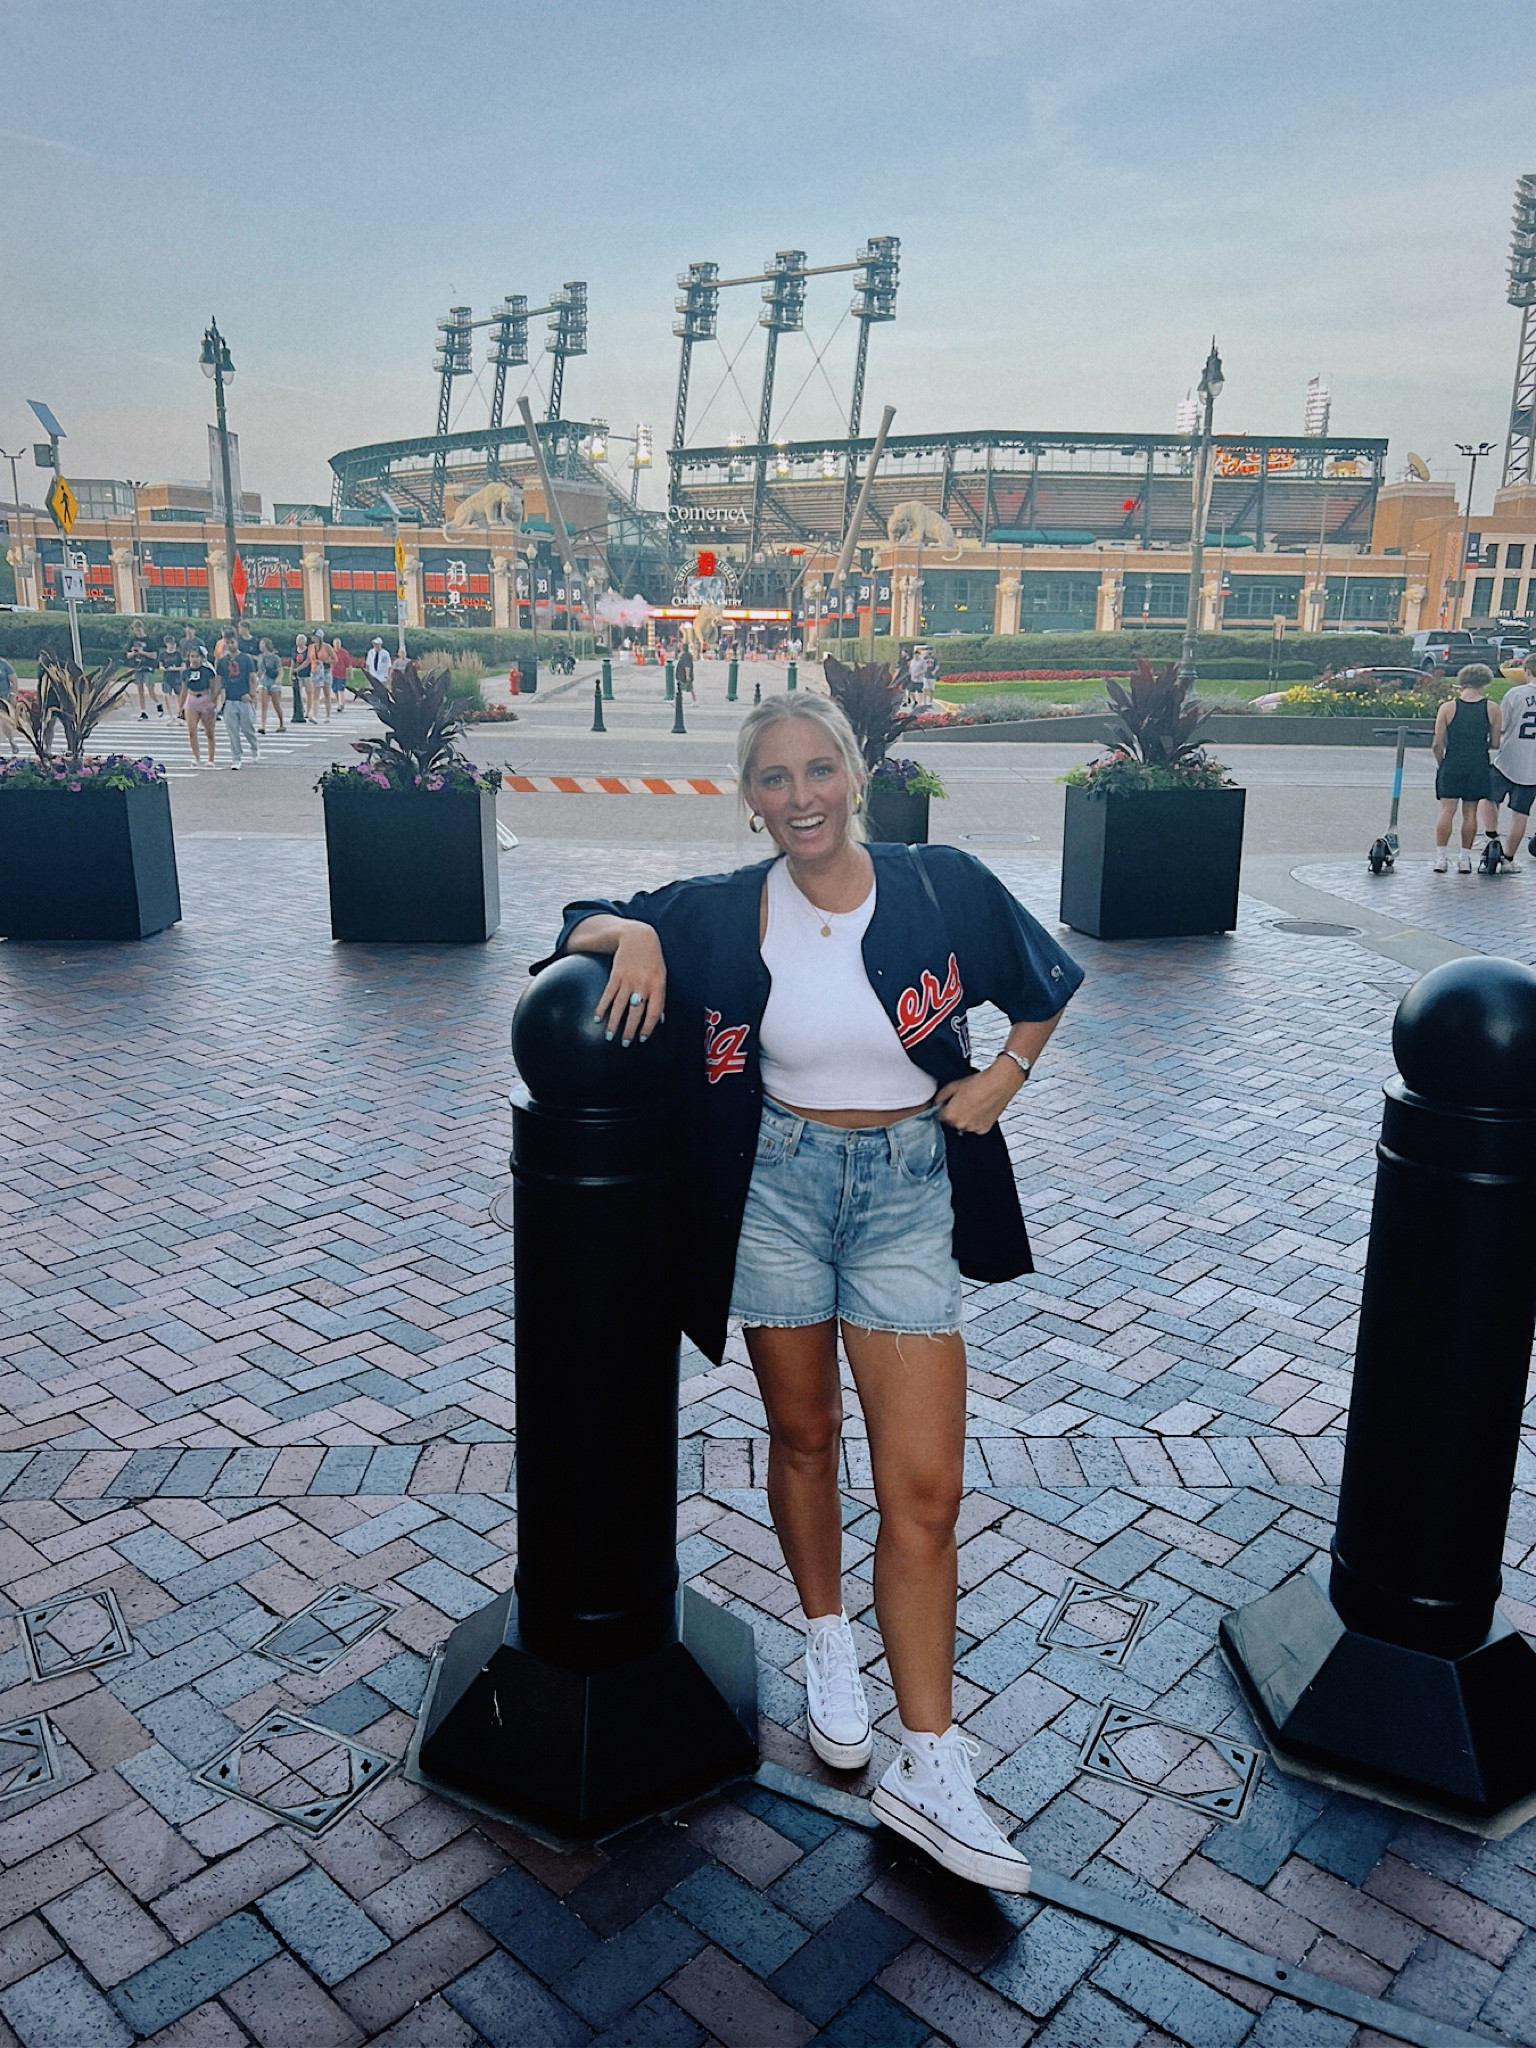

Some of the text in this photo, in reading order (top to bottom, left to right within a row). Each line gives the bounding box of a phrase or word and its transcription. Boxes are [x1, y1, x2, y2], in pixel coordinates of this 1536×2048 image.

[687, 525, 728, 533] PARK
[537, 578, 548, 594] D
[556, 588, 565, 601] D
[572, 588, 581, 601] D
[859, 585, 870, 601] D
[879, 586, 890, 601] D
[427, 596, 446, 605] THE
[461, 596, 486, 606] SHOP
[717, 597, 743, 607] ENTRY
[1519, 711, 1536, 739] 2
